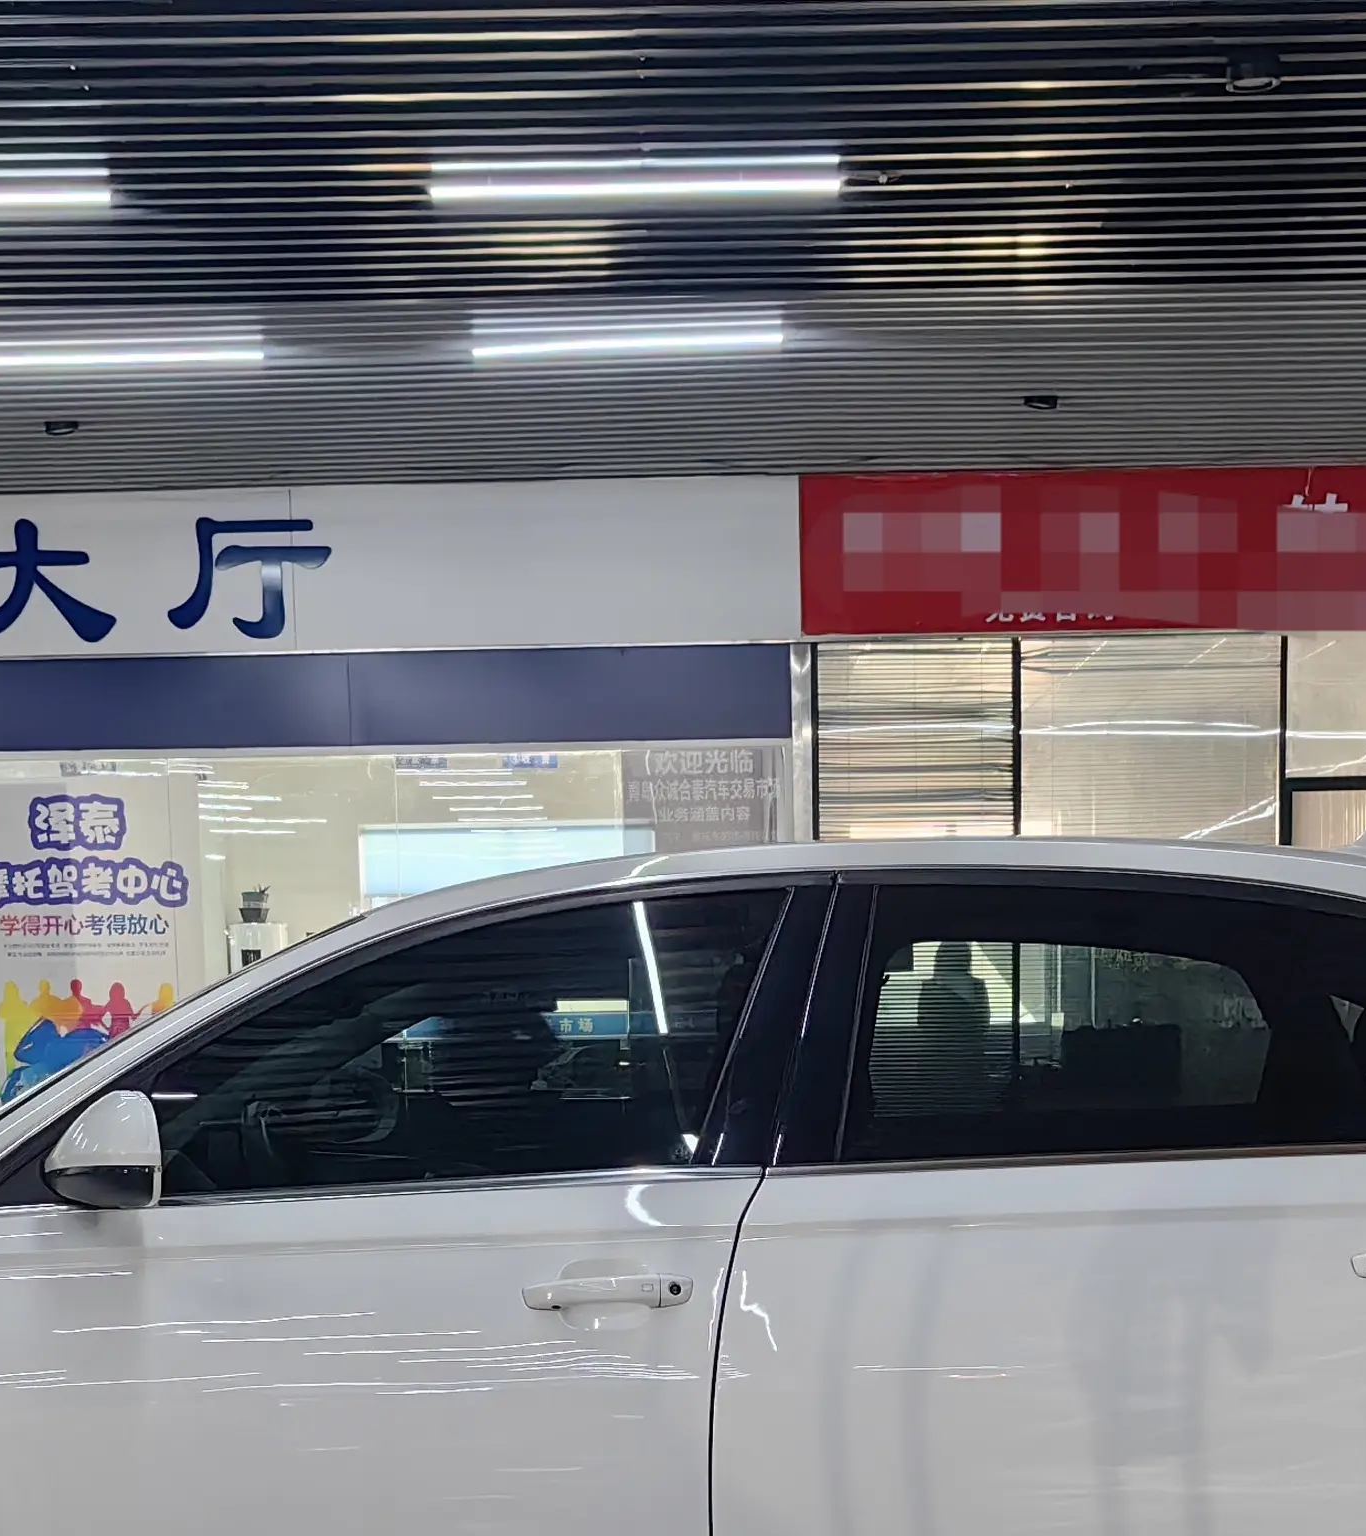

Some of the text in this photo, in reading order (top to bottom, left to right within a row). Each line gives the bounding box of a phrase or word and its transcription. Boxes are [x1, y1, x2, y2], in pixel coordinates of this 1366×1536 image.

[654, 750, 754, 775] 欢迎光临
[33, 797, 122, 847] 泽泰
[659, 805, 751, 823] 业务涵盖内容
[0, 914, 170, 937] 学得开心考得放心
